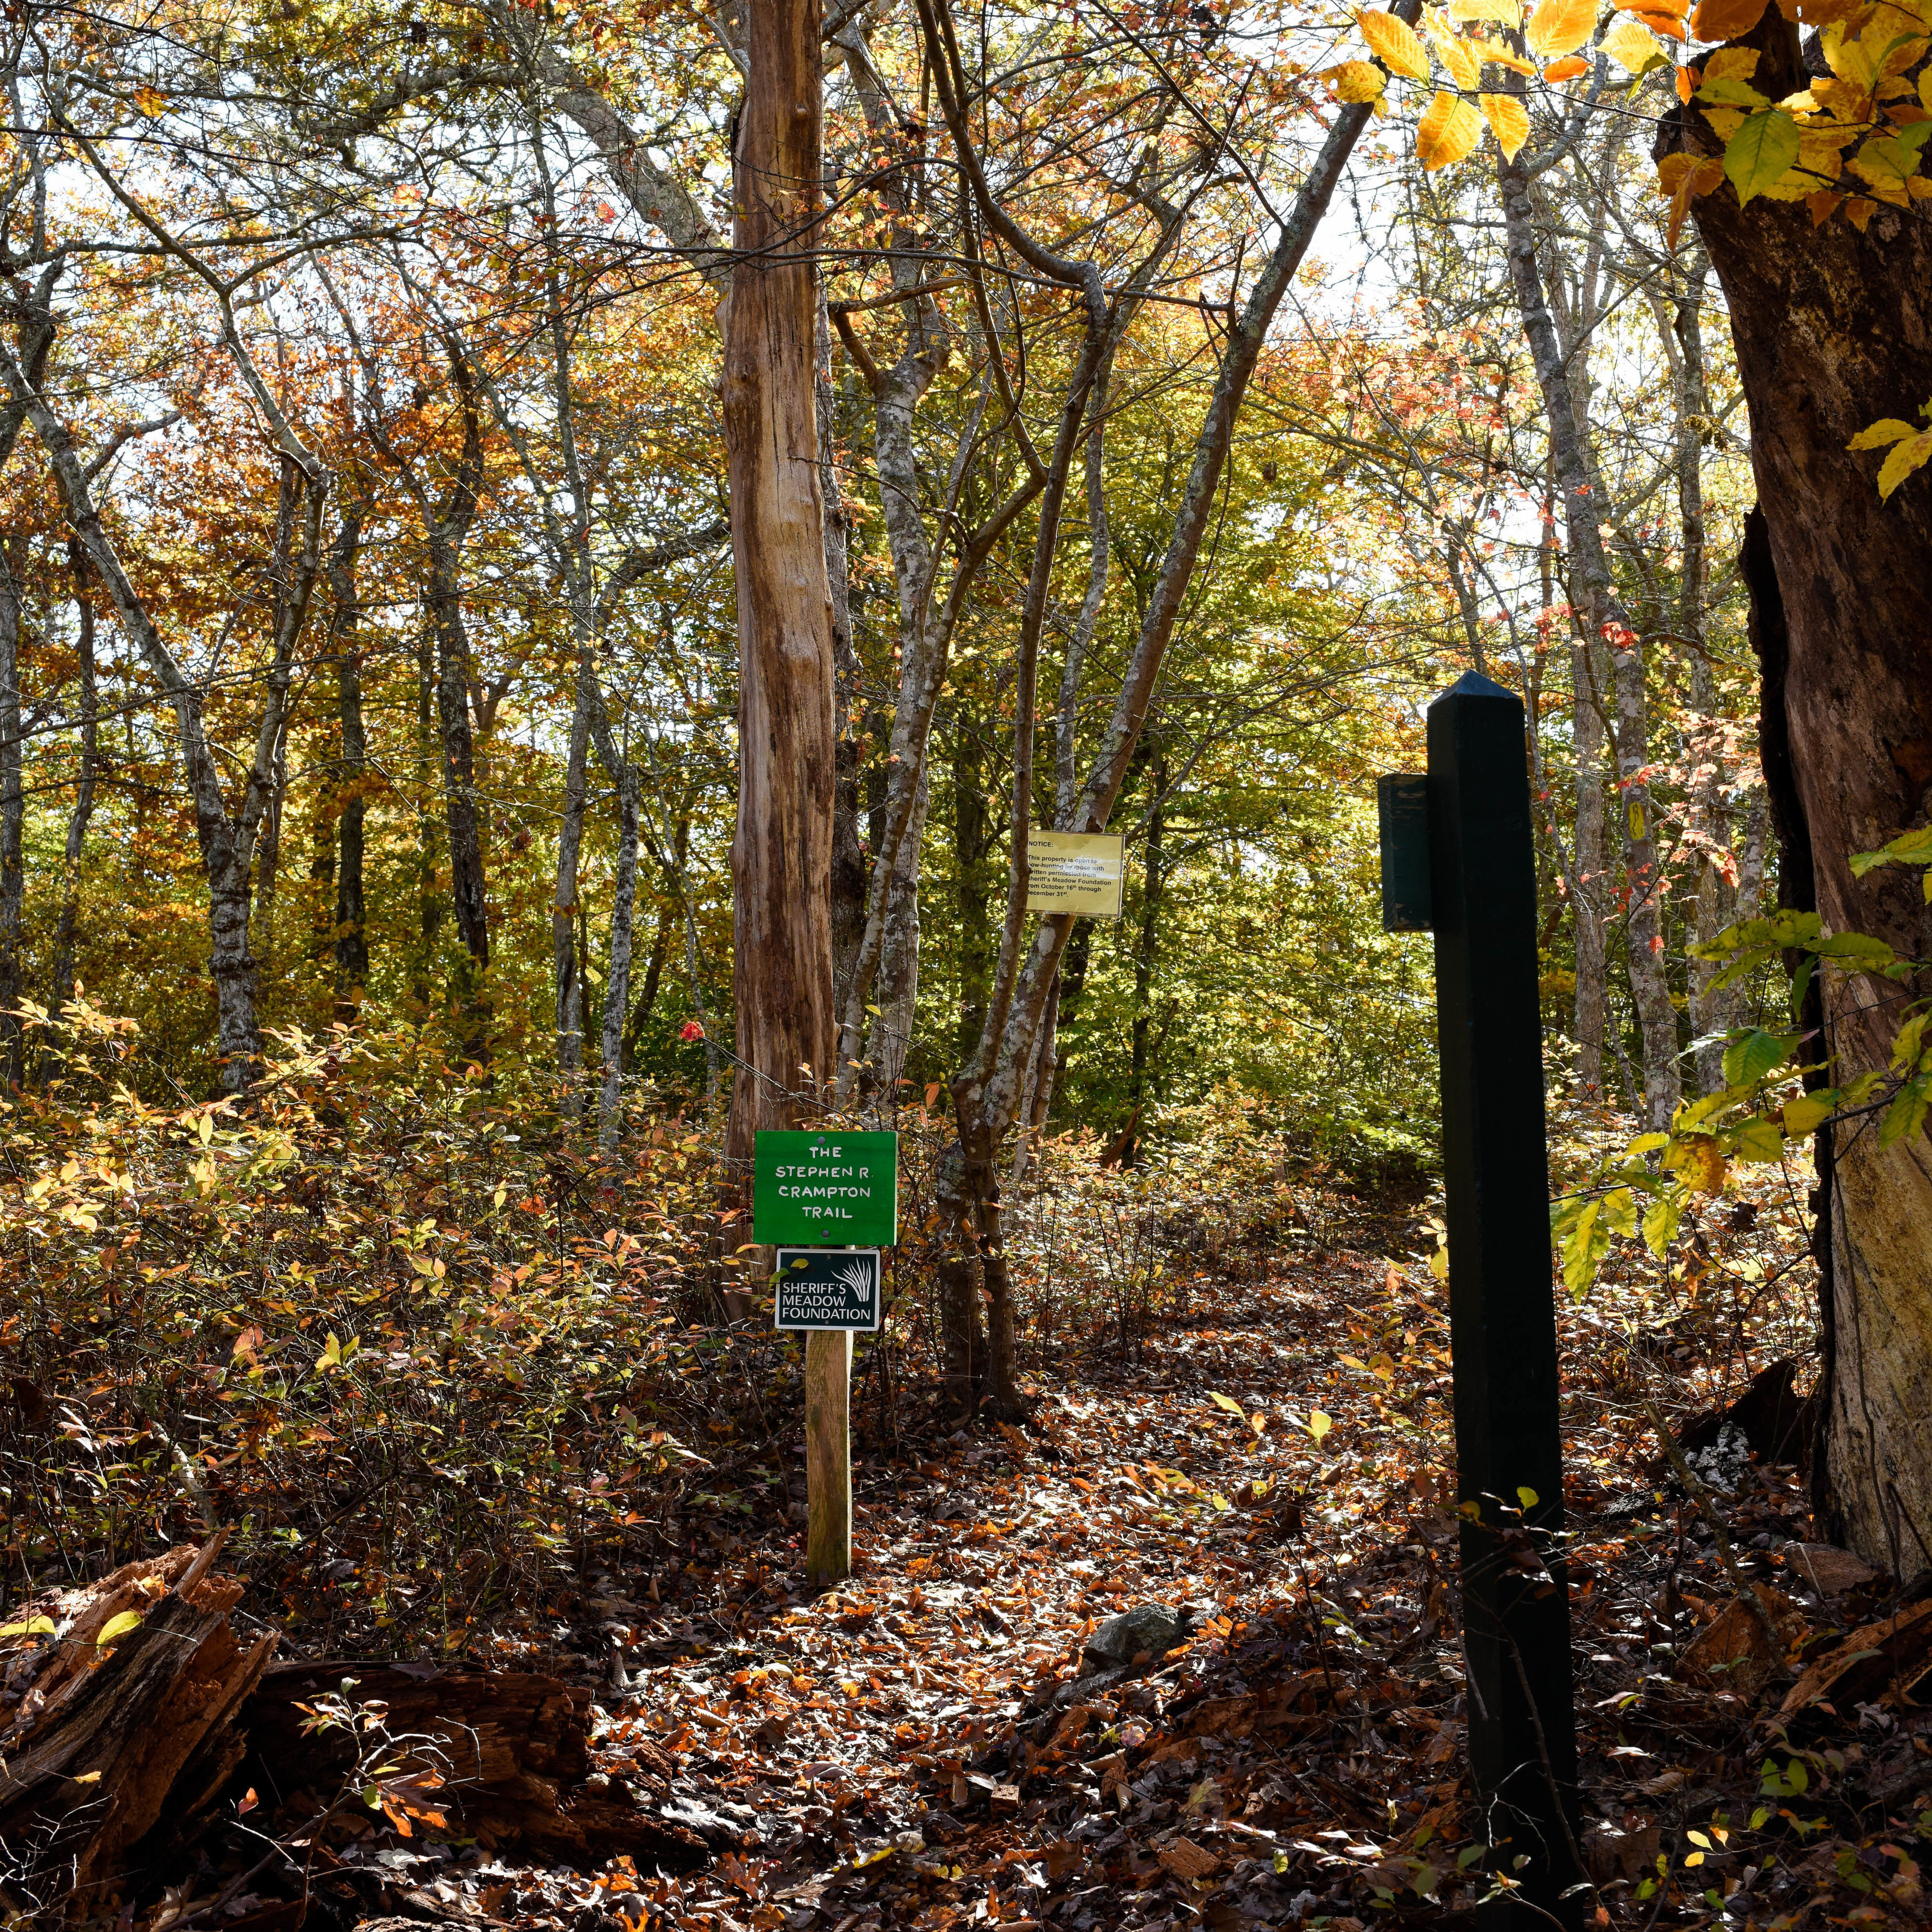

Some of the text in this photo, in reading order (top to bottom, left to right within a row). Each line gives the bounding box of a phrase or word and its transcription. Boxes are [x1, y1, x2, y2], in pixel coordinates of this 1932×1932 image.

[809, 1147, 842, 1158] THE
[775, 1166, 874, 1179] STEPHEN R.
[778, 1185, 871, 1198] CRAMPTON
[802, 1206, 853, 1219] TRAIL
[783, 1282, 846, 1294] SHERIFF'S
[783, 1295, 846, 1307] MEADOW
[782, 1308, 870, 1320] FOUNDATION
